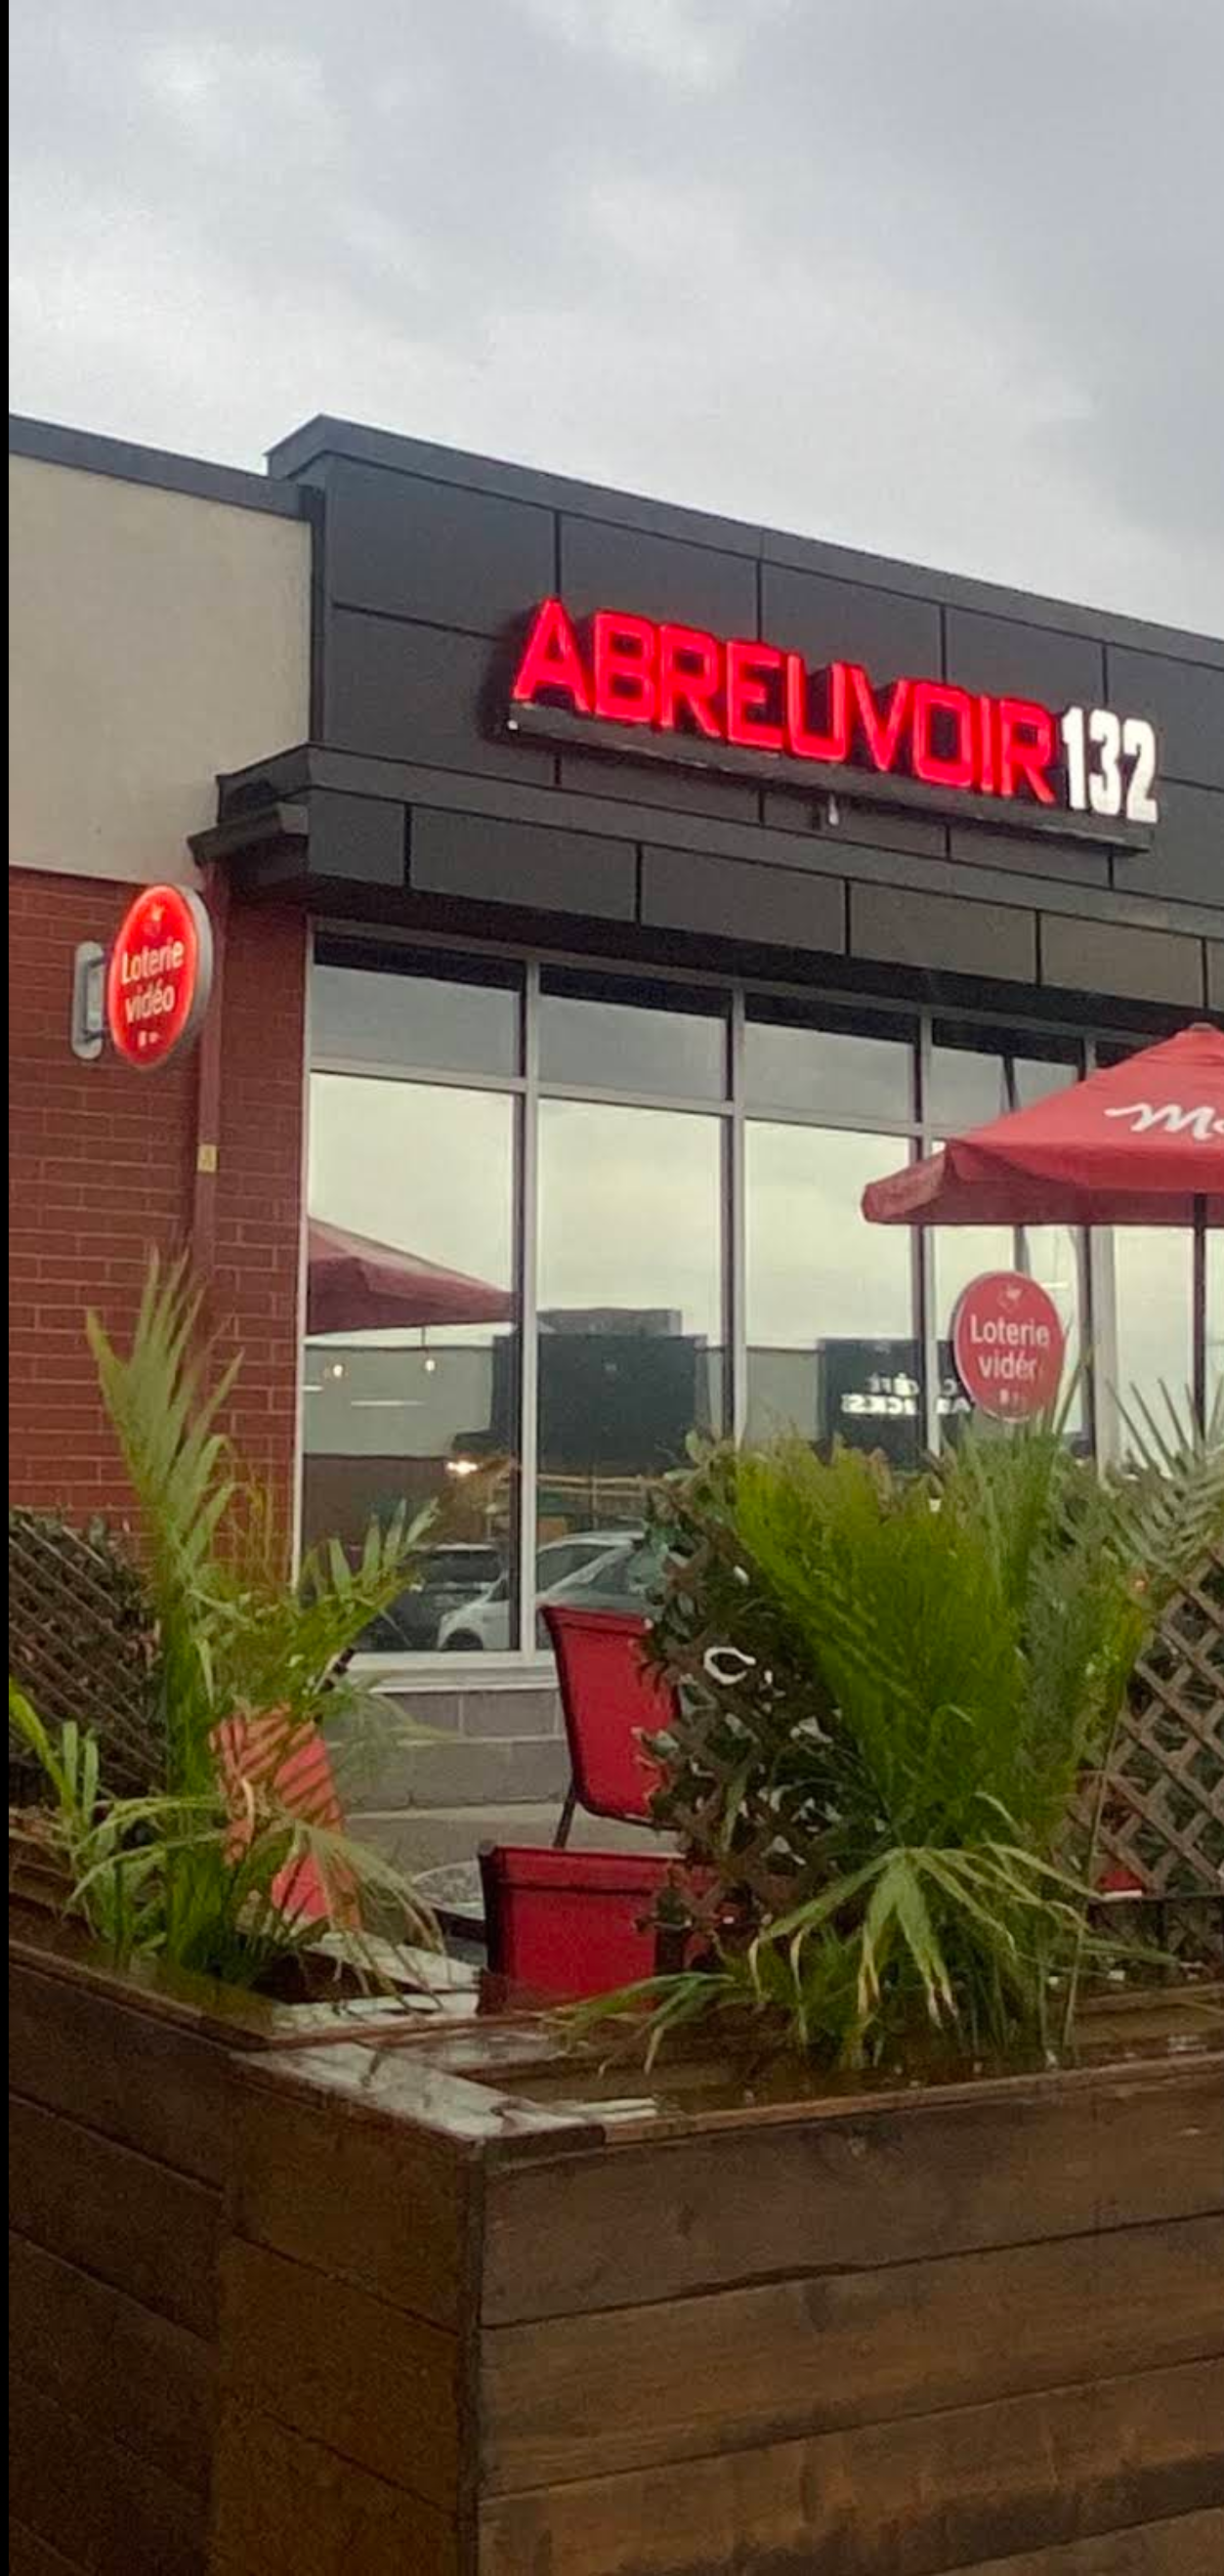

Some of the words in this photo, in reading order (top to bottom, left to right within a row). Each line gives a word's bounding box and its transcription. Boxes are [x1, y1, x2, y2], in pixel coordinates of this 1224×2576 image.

[513, 596, 1058, 805] ABREUVOIR
[1060, 705, 1160, 824] 132
[121, 935, 185, 985] Loterie
[124, 978, 176, 1024] vidéo
[970, 1313, 1050, 1347] Loterie
